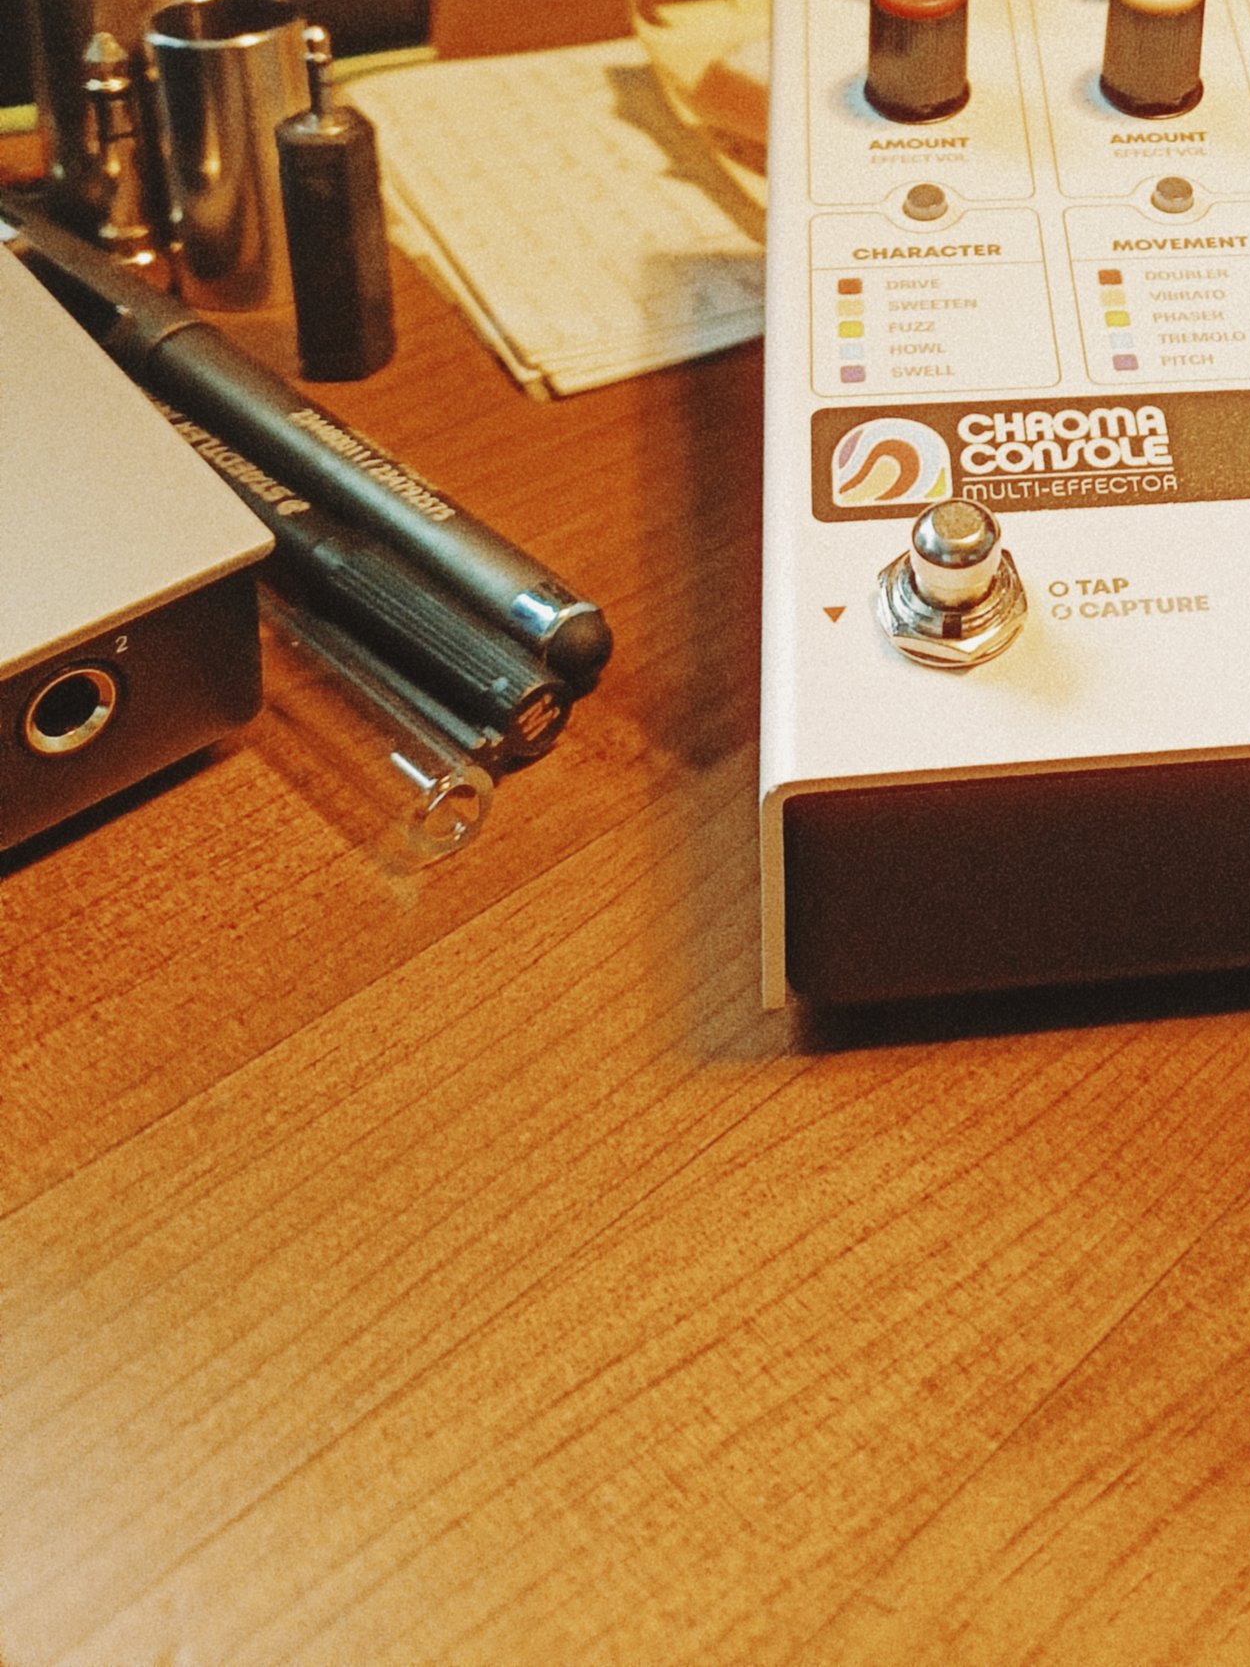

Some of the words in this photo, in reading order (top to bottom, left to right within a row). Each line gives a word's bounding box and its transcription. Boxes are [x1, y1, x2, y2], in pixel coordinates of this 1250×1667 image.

[869, 137, 970, 150] AMOUNT
[1110, 131, 1207, 144] AMOUNT
[1112, 236, 1248, 251] MOVEMENT
[852, 244, 1002, 260] CHARACTER
[1144, 269, 1229, 281] DOUBLER
[885, 278, 940, 290] DRIVE
[1150, 289, 1226, 301] VIBRATO
[887, 298, 978, 312] SWEETEN
[1152, 310, 1225, 323] PHASER
[888, 321, 935, 333] FUZZ
[1158, 331, 1246, 344] TREMOLO
[889, 342, 946, 355] HOWL
[1161, 353, 1214, 366] PITCH
[891, 364, 955, 378] SWELL
[957, 405, 1168, 444] CHROMA
[960, 435, 1173, 475] CONSOLE
[962, 474, 1178, 501] MULTI-EFFECTOR
[1075, 577, 1130, 596] TAP
[1079, 595, 1210, 620] CAPTURE
[115, 635, 129, 653] 2
